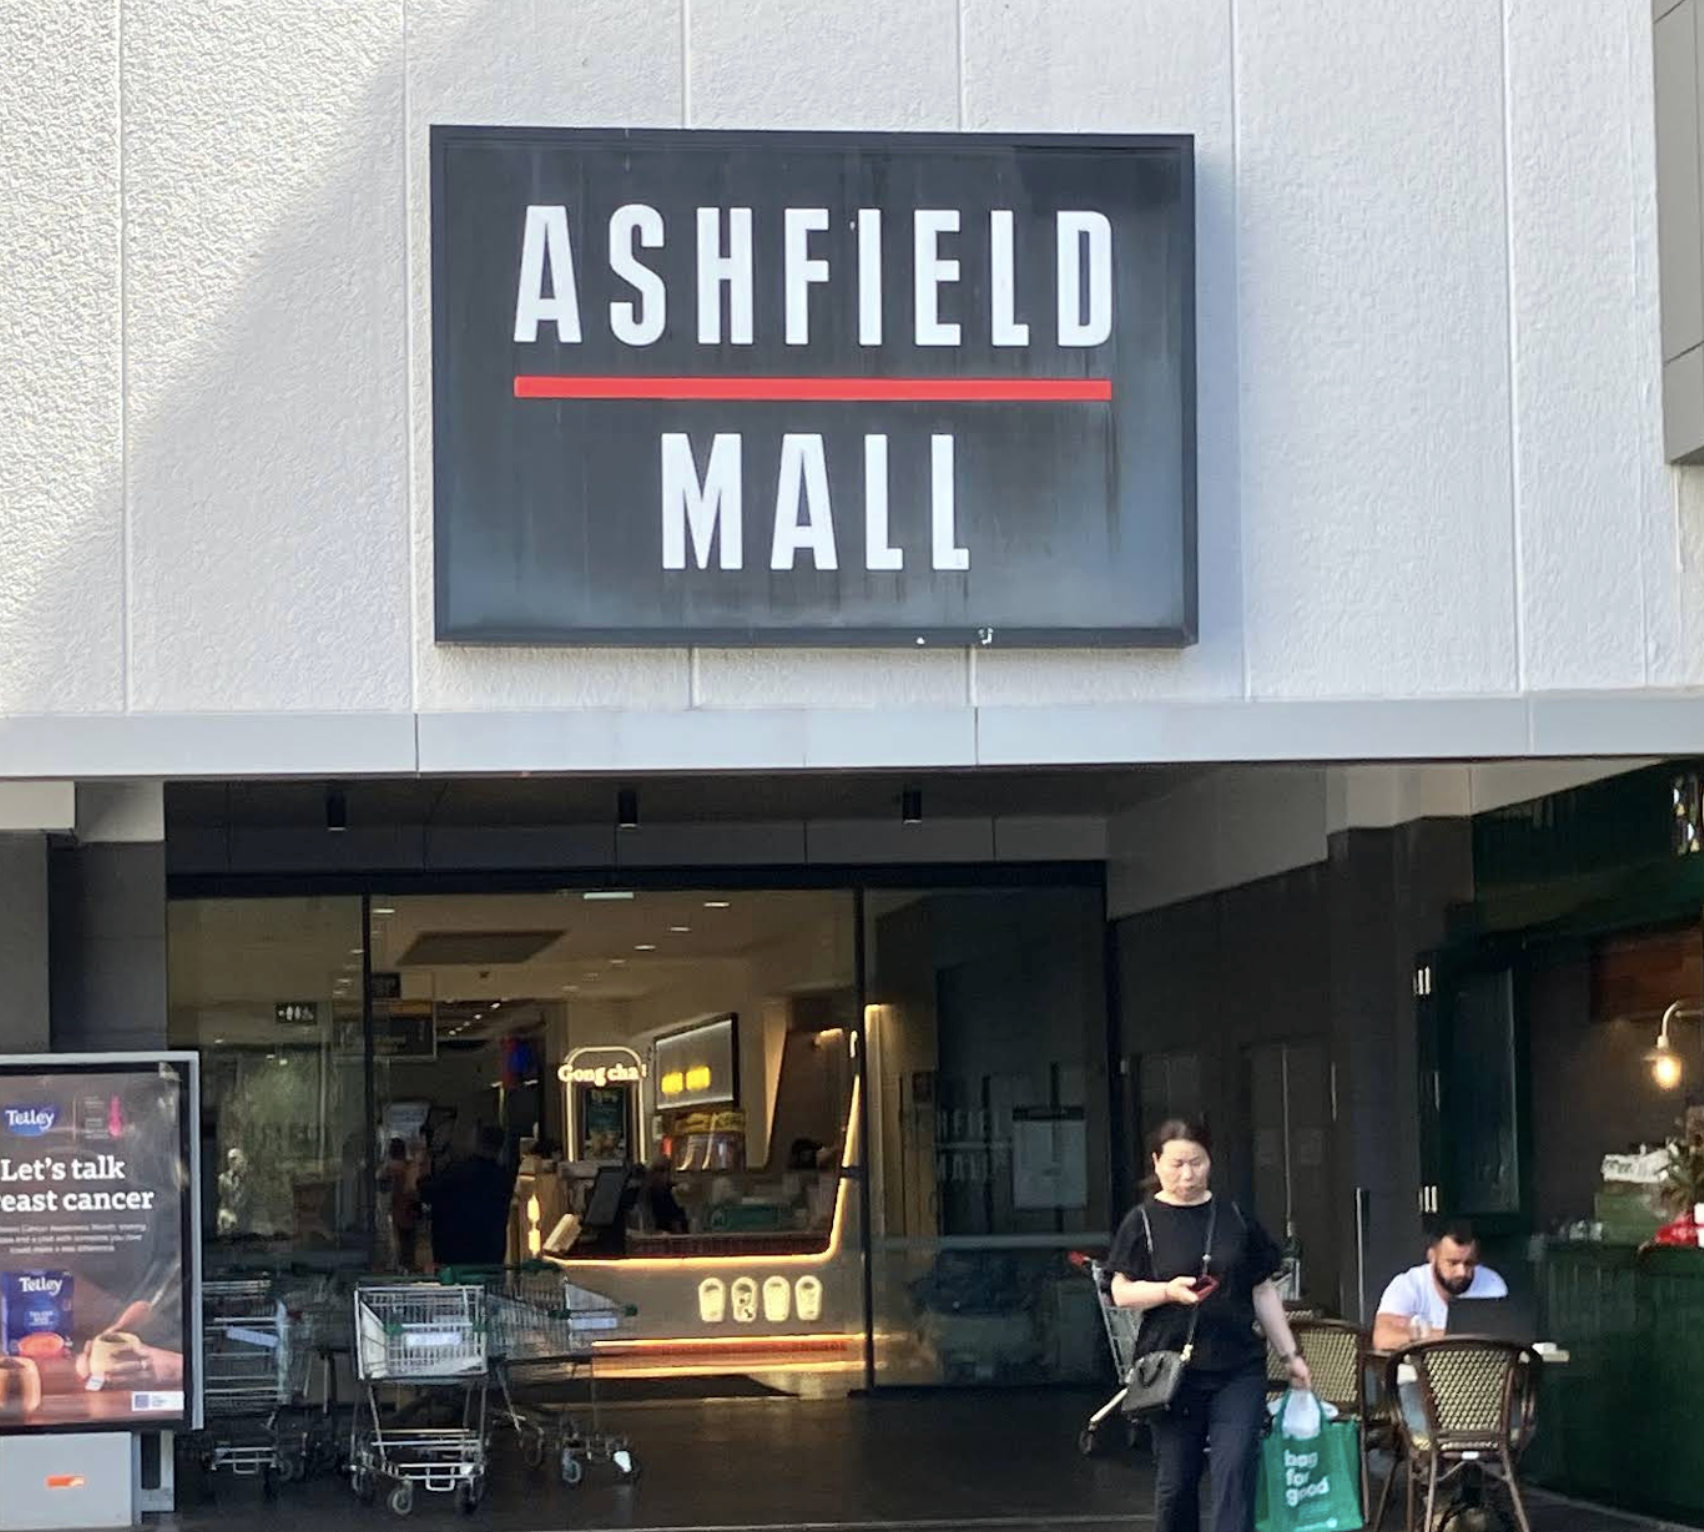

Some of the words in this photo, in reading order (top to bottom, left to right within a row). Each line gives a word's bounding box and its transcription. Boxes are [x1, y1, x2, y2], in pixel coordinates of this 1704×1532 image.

[513, 204, 1112, 347] ASHFIELD
[661, 433, 970, 570] MALL
[557, 1063, 606, 1087] Gong
[607, 1063, 640, 1081] cha
[5, 1107, 55, 1131] Tetley
[0, 1157, 67, 1181] Let's
[71, 1154, 126, 1180] talk
[0, 1189, 58, 1212] east
[62, 1191, 154, 1212] cancer
[19, 1276, 63, 1296] Tetley
[1284, 1449, 1318, 1469] bag
[1285, 1475, 1330, 1507] good
